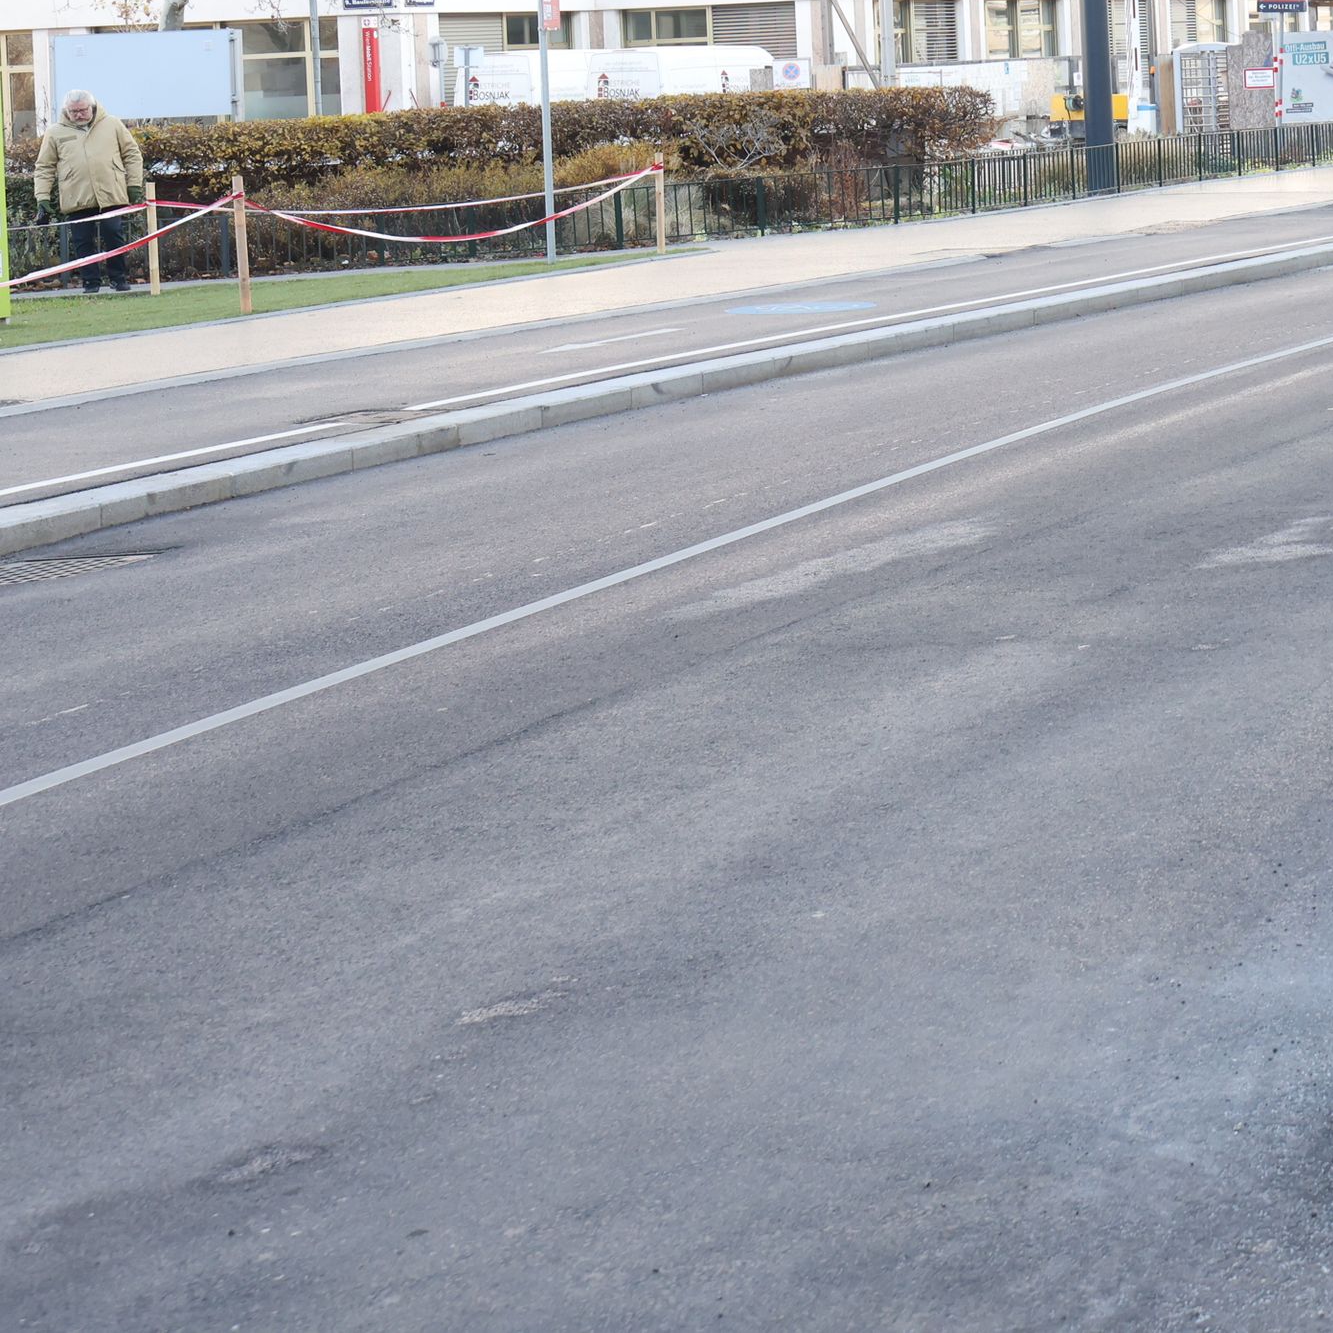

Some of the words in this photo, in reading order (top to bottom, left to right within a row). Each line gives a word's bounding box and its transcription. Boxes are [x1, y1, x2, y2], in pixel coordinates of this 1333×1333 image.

[1295, 53, 1327, 65] U2xU5
[473, 90, 510, 101] BOSNJAK
[604, 87, 640, 97] BOSNJAK
